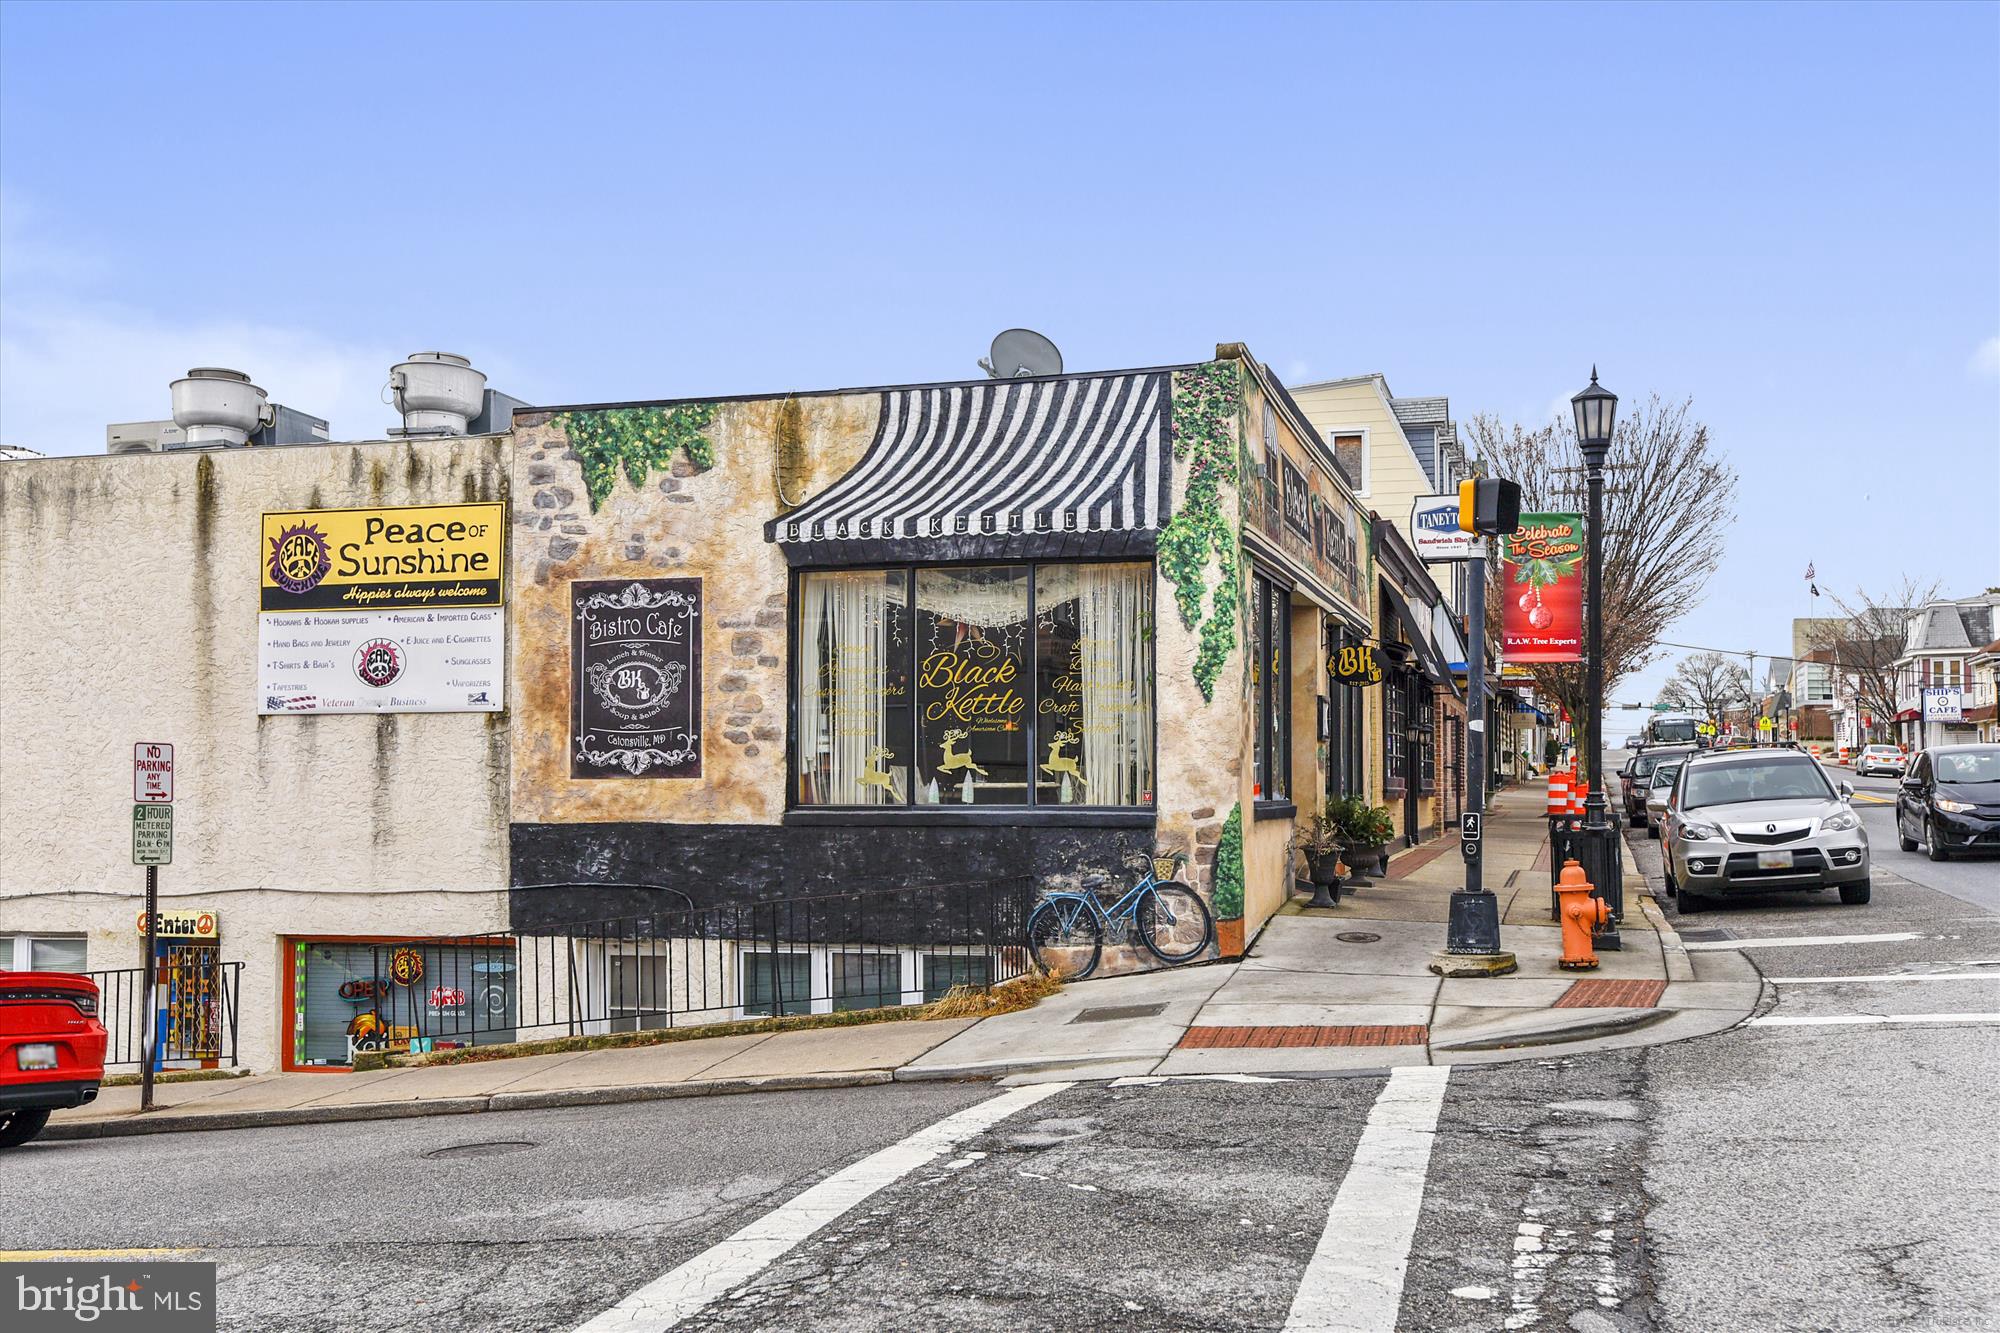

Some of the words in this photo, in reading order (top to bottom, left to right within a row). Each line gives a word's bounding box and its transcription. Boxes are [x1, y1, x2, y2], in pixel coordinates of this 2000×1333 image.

[788, 521, 893, 539] BLACK
[929, 512, 1075, 535] KETTLE
[1421, 512, 1459, 528] TANEYT
[365, 517, 466, 545] Peace
[468, 524, 488, 537] OF
[1508, 524, 1572, 543] Celebrate
[281, 536, 319, 571] PEACE
[1507, 543, 1527, 556] The
[1527, 540, 1579, 558] Season
[338, 543, 489, 577] Sunshine
[271, 563, 328, 592] SUNSHINE
[342, 584, 392, 604] Hippies
[393, 583, 436, 602] always
[438, 582, 487, 597] welcome
[303, 617, 311, 626] &
[341, 617, 369, 625] SUPPLIES
[393, 614, 425, 623] AMERICAN
[427, 613, 435, 622] &
[437, 613, 469, 621] IMPORTED
[470, 612, 492, 620] GLASS
[589, 618, 641, 640] Bistro
[646, 612, 684, 641] Cafe
[292, 639, 309, 647] BAGS
[324, 639, 351, 647] JEWELRY
[1507, 637, 1531, 645] R.A.W.
[1549, 638, 1577, 646] Experts
[450, 657, 491, 665] SUNGLASSES
[606, 650, 630, 665] Lunch
[631, 649, 638, 657] &
[638, 649, 664, 664] Dinner
[1339, 646, 1373, 676] BK
[302, 660, 311, 669] &
[920, 652, 1017, 688] Black
[617, 669, 643, 689] BK
[272, 683, 308, 691] TAPESTRIES
[1926, 687, 1960, 696] SHIP'S
[321, 698, 355, 707] Veteran
[390, 697, 427, 706] Business
[927, 684, 1025, 722] Kettle
[1038, 698, 1080, 716] Craft
[609, 707, 630, 721] Soup
[631, 713, 638, 721] &
[638, 706, 661, 720] Salad
[1929, 706, 1958, 714] CAFE
[652, 734, 666, 746] MD
[147, 747, 161, 759] NO
[136, 760, 171, 773] PARKING
[146, 773, 161, 781] ANY
[146, 782, 162, 790] TIME
[136, 807, 143, 819] 2
[147, 807, 171, 819] HOUR
[135, 822, 171, 830] METERED
[137, 831, 168, 839] PARKING
[156, 912, 196, 934] Enter
